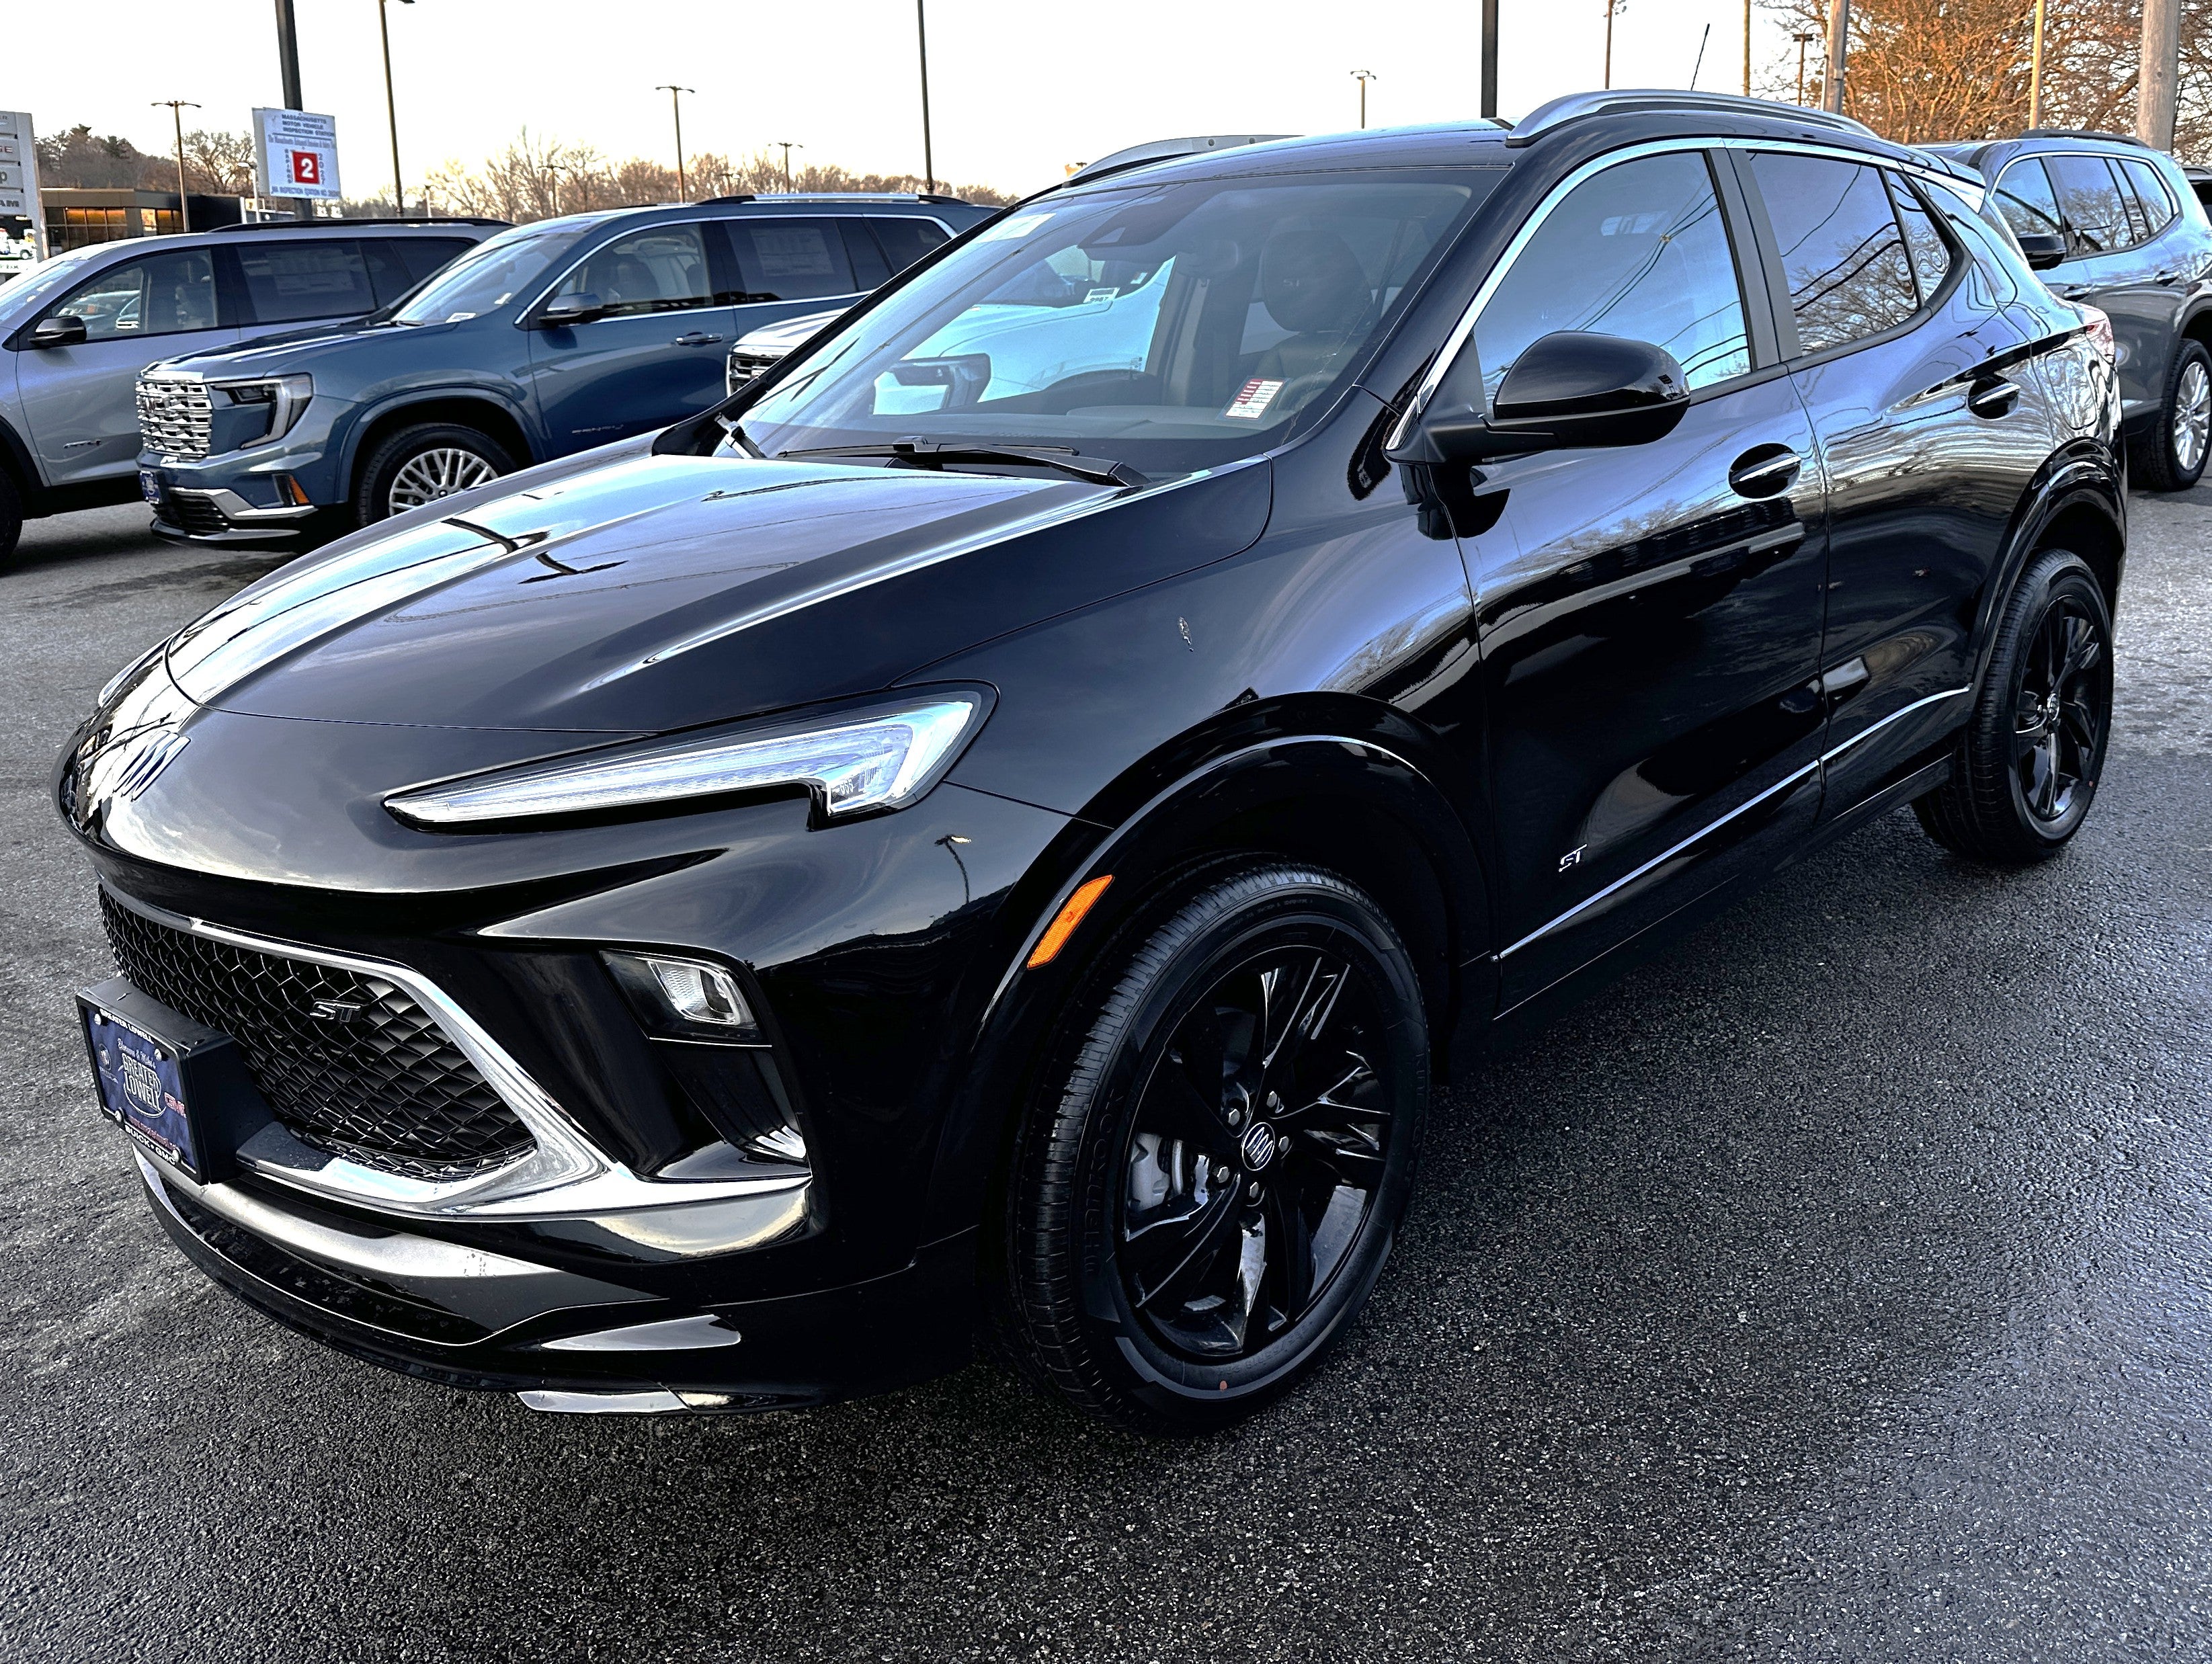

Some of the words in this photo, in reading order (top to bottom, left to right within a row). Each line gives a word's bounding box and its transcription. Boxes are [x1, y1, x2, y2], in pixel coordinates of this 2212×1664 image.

[301, 158, 313, 178] 2
[1559, 843, 1588, 872] ST
[99, 1008, 128, 1029] GREATER
[128, 1023, 155, 1044] LOWELL
[310, 1000, 361, 1022] ST
[122, 1052, 161, 1092] GREATER
[124, 1071, 162, 1113] LOWELL
[124, 1124, 150, 1148] BUICK
[155, 1147, 175, 1165] GMC
